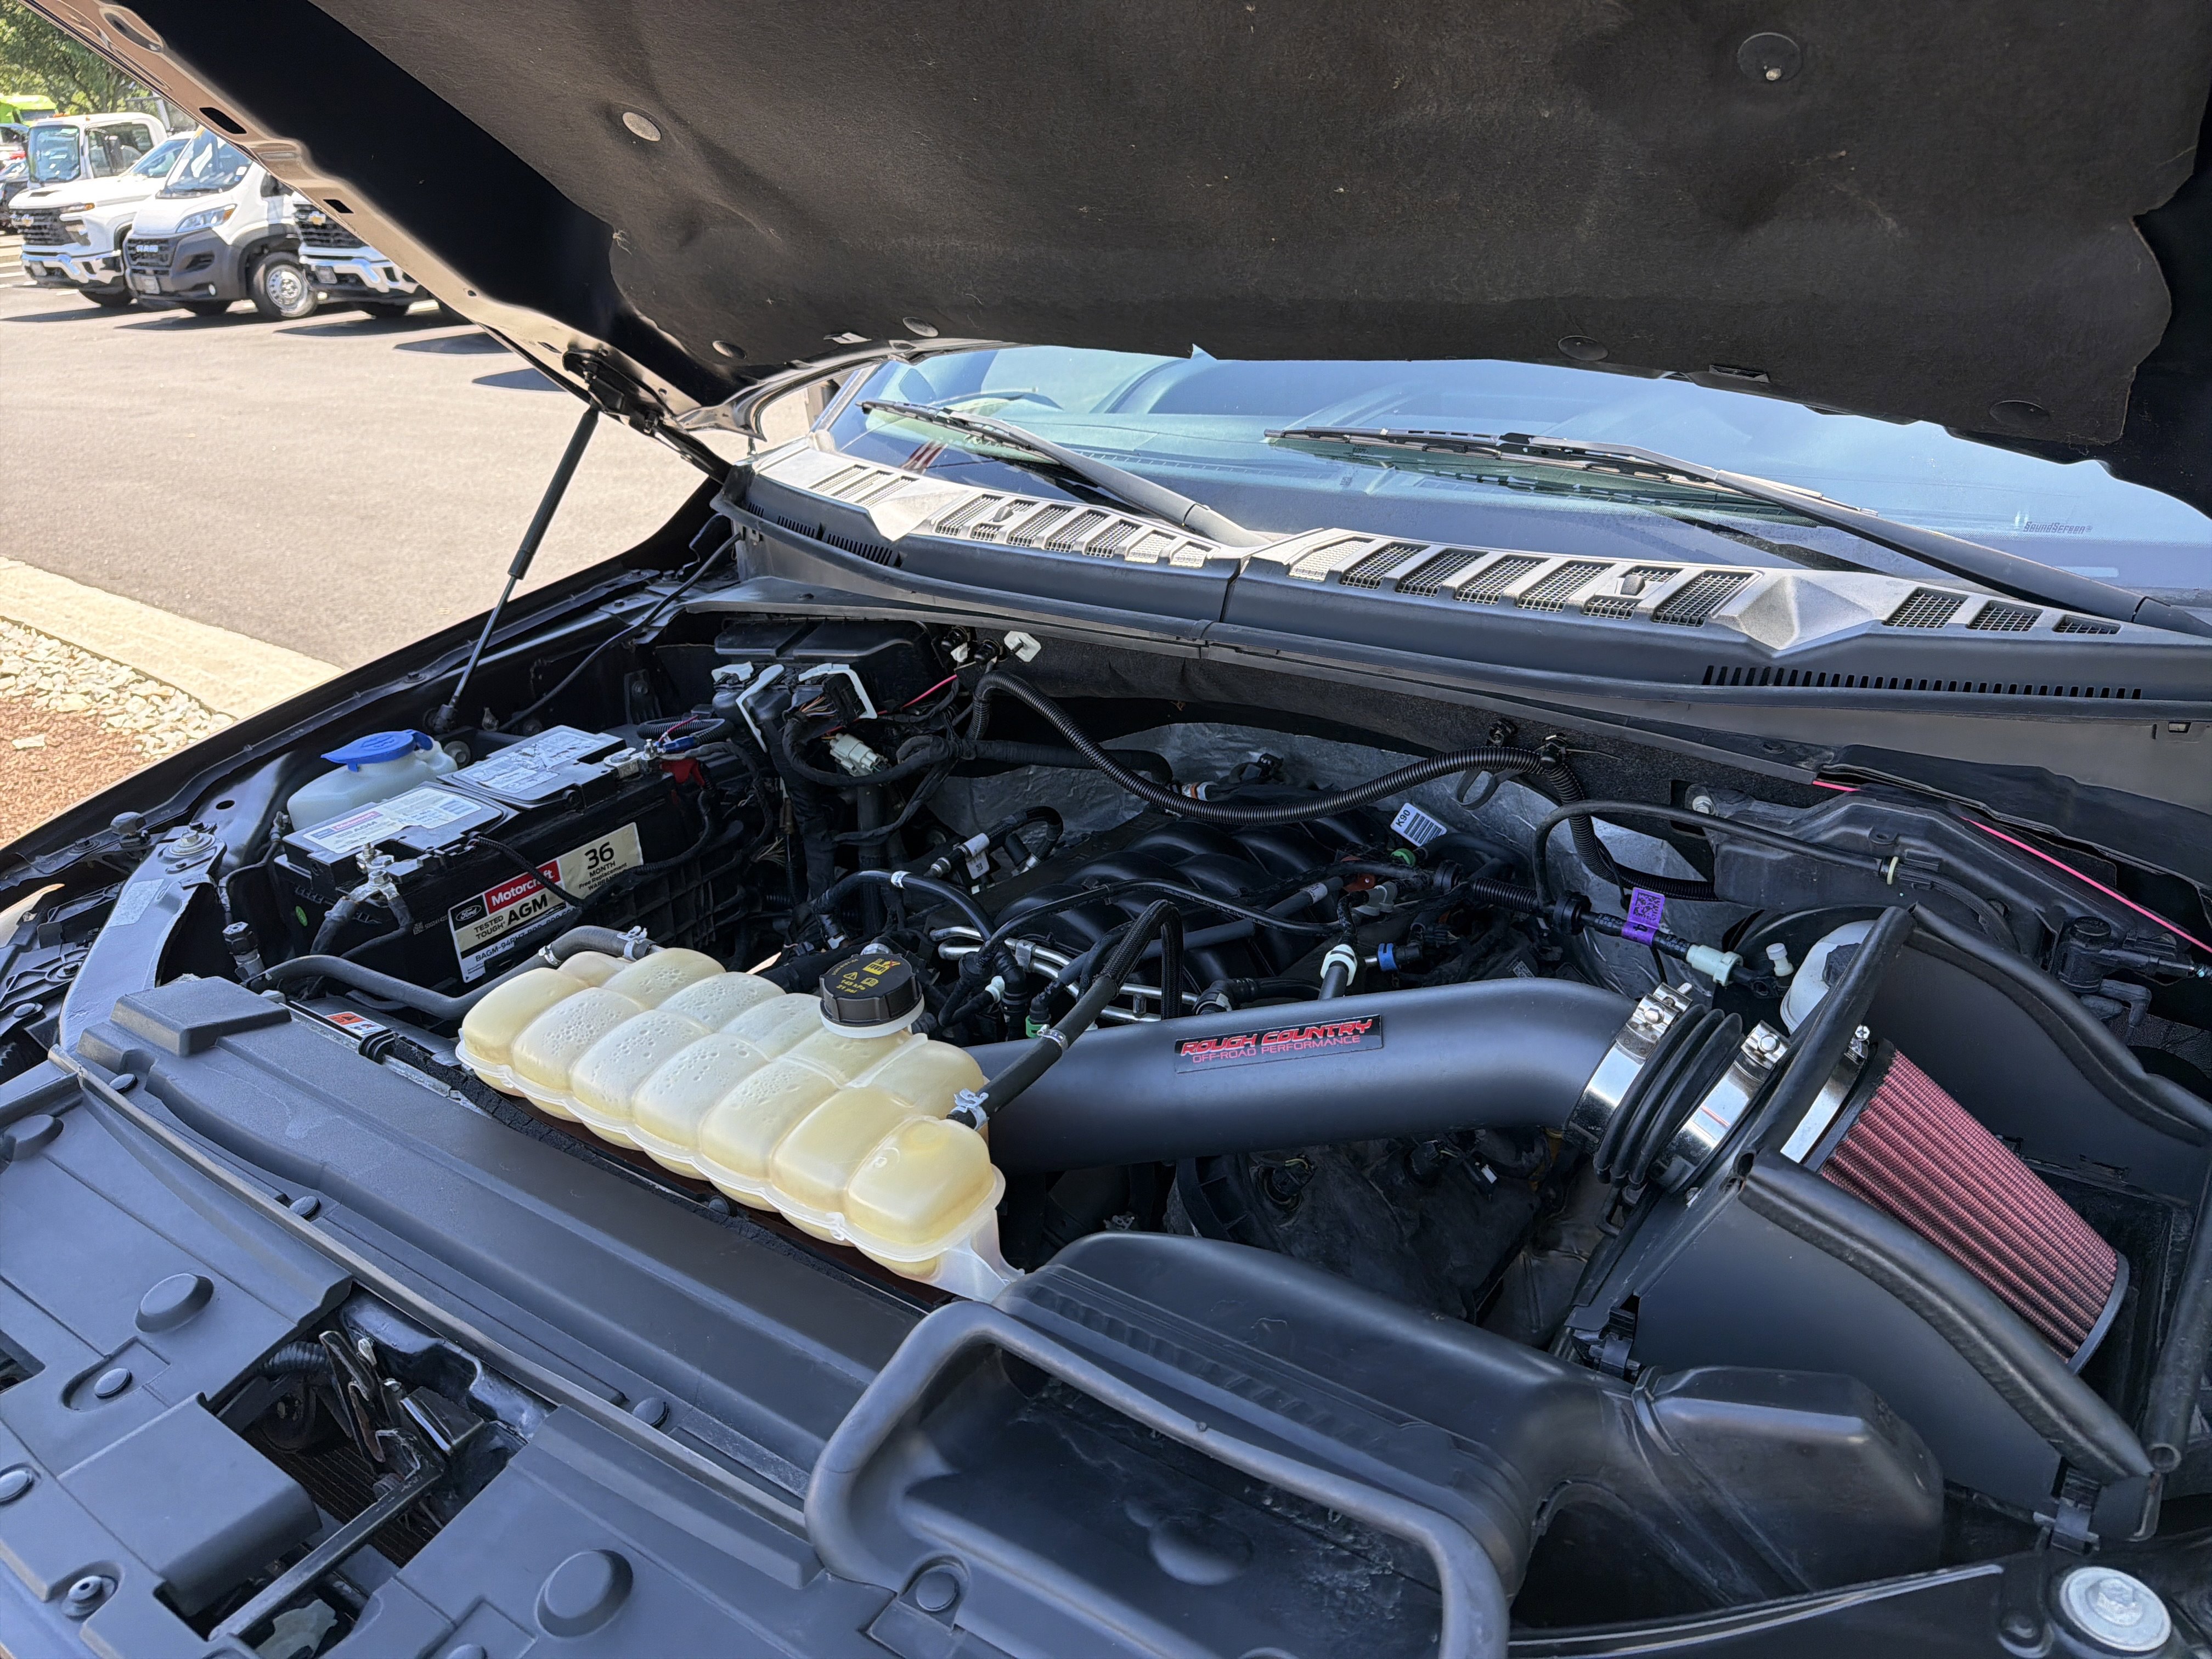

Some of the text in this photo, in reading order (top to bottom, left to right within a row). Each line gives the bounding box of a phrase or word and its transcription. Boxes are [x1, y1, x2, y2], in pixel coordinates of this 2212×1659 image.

[1395, 809, 1410, 827] K90
[584, 841, 614, 870] 36
[589, 860, 616, 878] MONTH
[579, 862, 627, 889] Free Replacement
[460, 907, 477, 919] Ford
[507, 894, 548, 926] AGM
[474, 915, 504, 933] TESTED
[1180, 1019, 1373, 1057] ROUGH COUNTRY
[1192, 1034, 1361, 1064] OFF-ROAD PERFORMANCE
